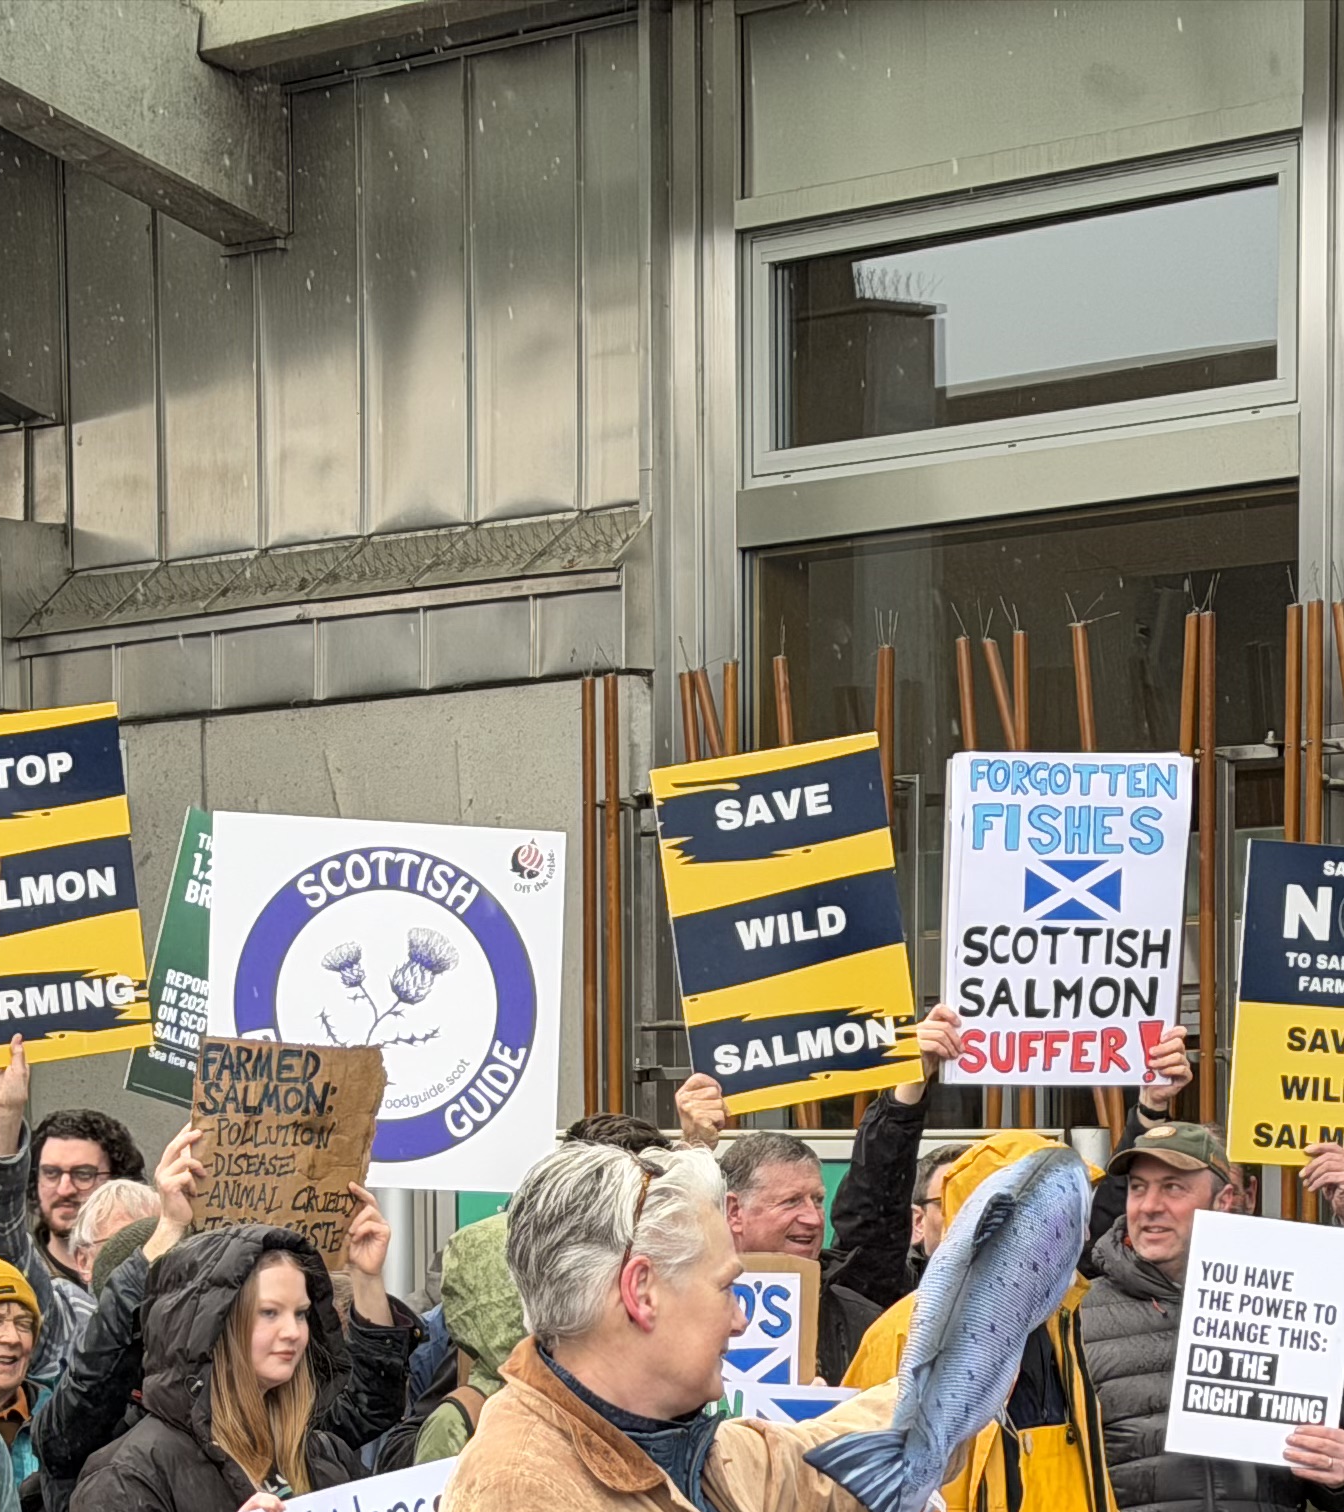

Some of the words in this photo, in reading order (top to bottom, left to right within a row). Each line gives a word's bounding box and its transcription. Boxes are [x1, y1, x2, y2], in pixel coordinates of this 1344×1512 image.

[970, 759, 1178, 800] FORGOTTEN
[715, 783, 833, 831] SAVE
[972, 803, 1164, 855] FISHES
[297, 850, 480, 915] SCOTTISH
[735, 905, 847, 951] WILD
[963, 925, 1171, 969] SCOTTISH
[1285, 952, 1311, 968] TO
[157, 1004, 179, 1024] ON
[161, 986, 178, 1005] IN
[959, 976, 1159, 1019] SALMON
[148, 1046, 167, 1062] Sea
[200, 1042, 321, 1085] FARMED
[713, 1015, 896, 1076] SALMON
[197, 1081, 338, 1117] SALMON:
[444, 1039, 527, 1139] GUIDE
[290, 1184, 359, 1218] CRUELTY
[1200, 1260, 1238, 1284] YOU
[1244, 1266, 1294, 1292] HAVE
[1197, 1288, 1235, 1312] THE
[1239, 1293, 1307, 1322] POWER
[1313, 1302, 1337, 1326] TO
[1192, 1315, 1271, 1346] CHANGE
[1278, 1326, 1329, 1353] THIS:
[1192, 1347, 1224, 1374] DO
[1229, 1352, 1272, 1381] THE
[1187, 1385, 1254, 1416] RIGHT
[1258, 1391, 1324, 1425] THING
